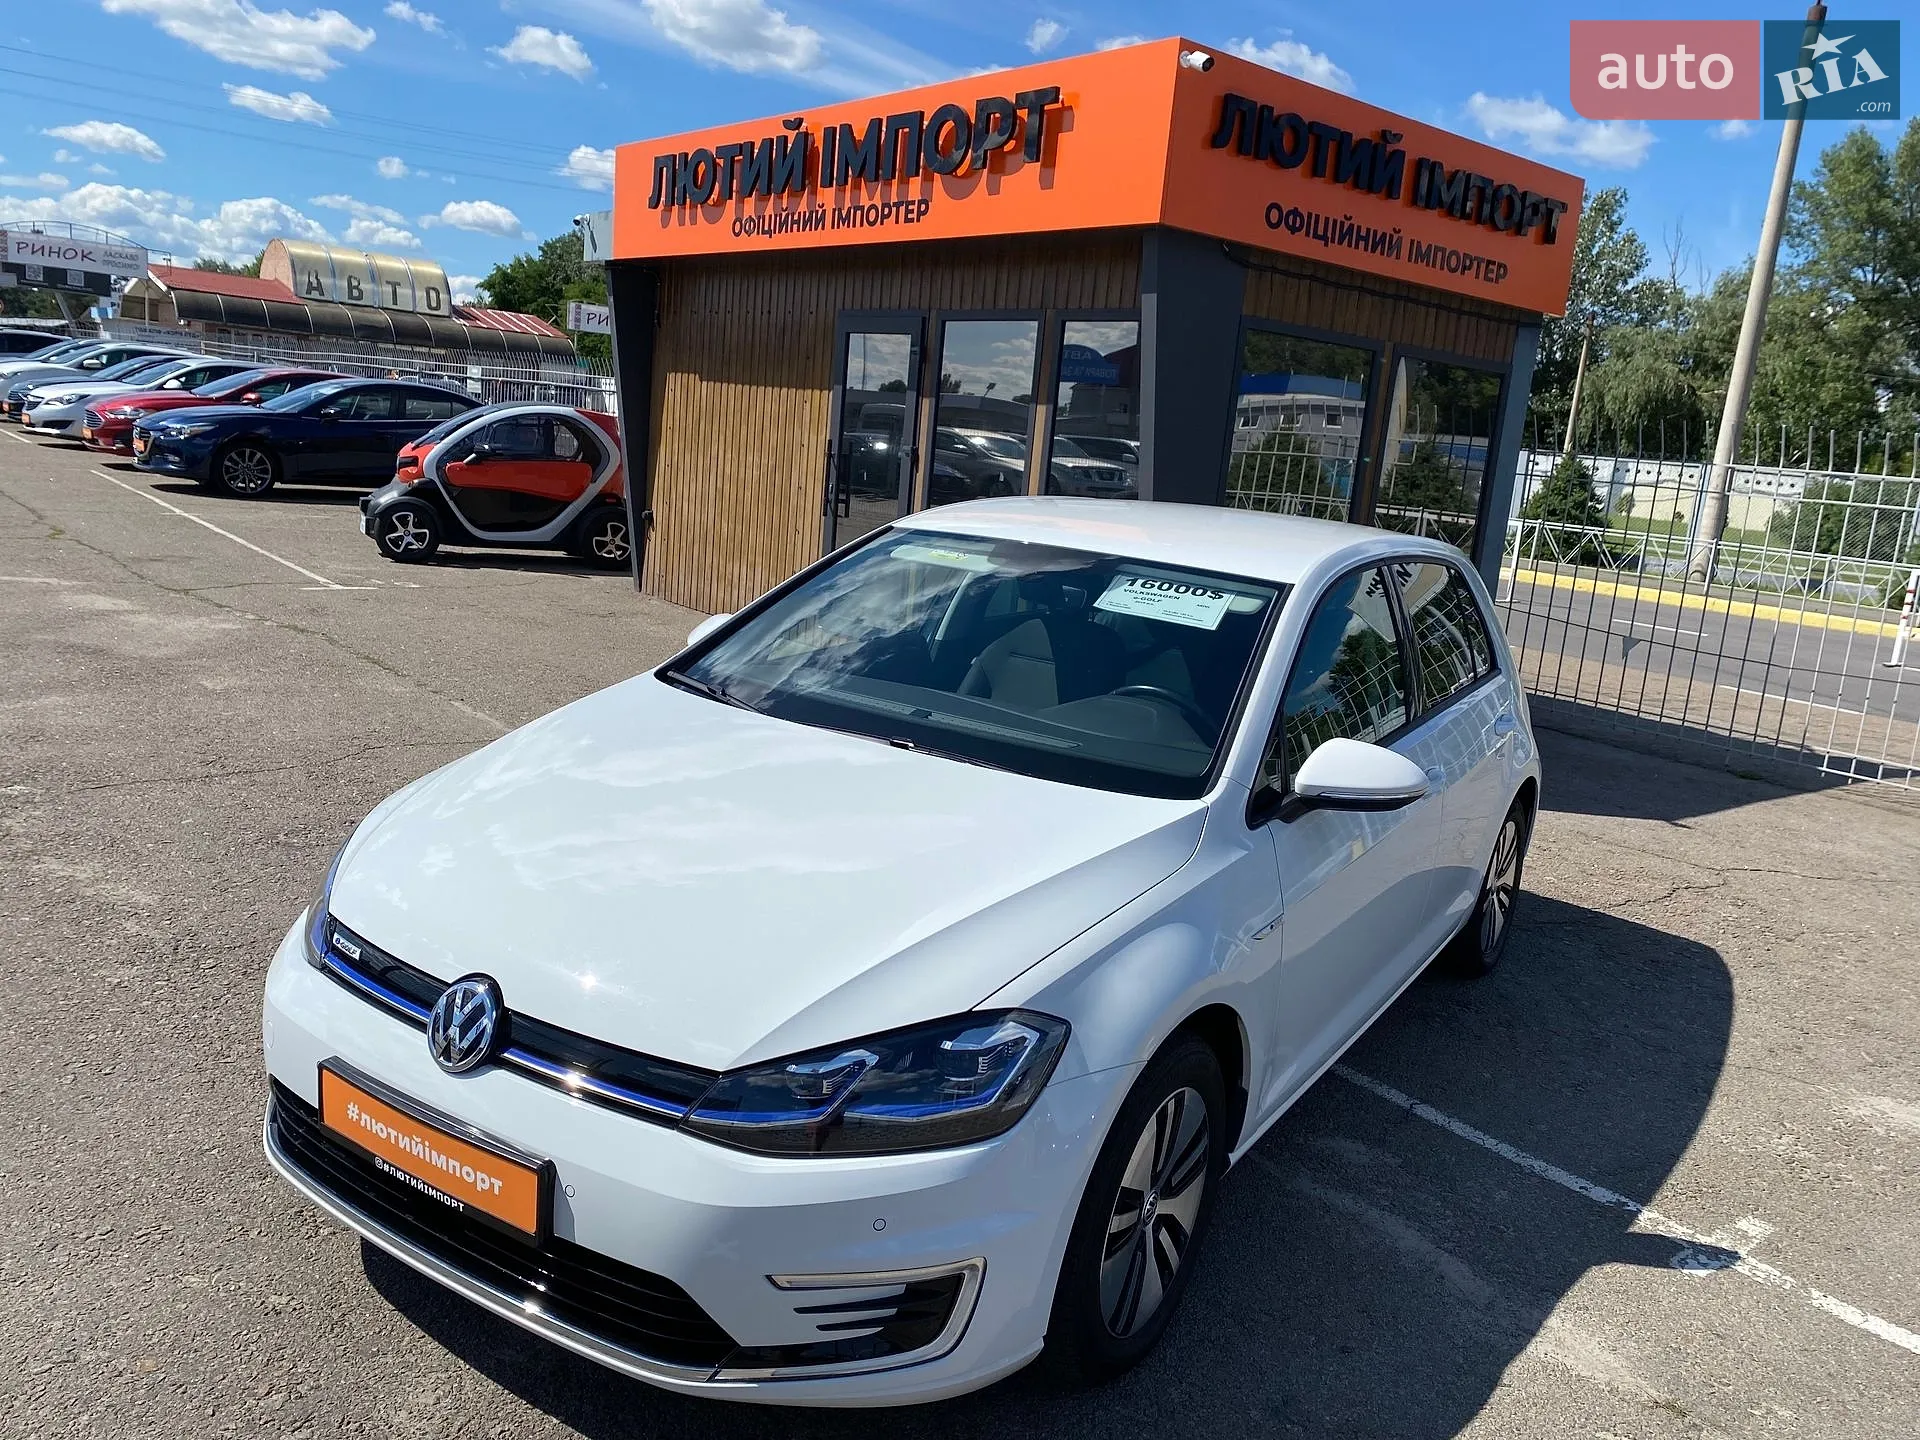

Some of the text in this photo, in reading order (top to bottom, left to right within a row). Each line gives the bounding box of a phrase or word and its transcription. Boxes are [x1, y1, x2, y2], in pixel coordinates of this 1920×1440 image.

[648, 86, 1061, 210] ЛЮТИЙ ІМПОРТ
[1211, 92, 1568, 245] ЛЮТИЙ ІМПОРТ
[731, 199, 929, 239] ОФІЦІЙНИЙ ІМПОРТЕР
[15, 241, 96, 263] РИНОК
[1265, 202, 1508, 285] ОФІЦІЙНИЙ ІМПОРТЕР
[305, 268, 442, 312] АВТО
[1123, 588, 1181, 600] VOLKSWAGEN
[1126, 577, 1225, 600] 16000$
[347, 1101, 503, 1196] #лютийімпорт
